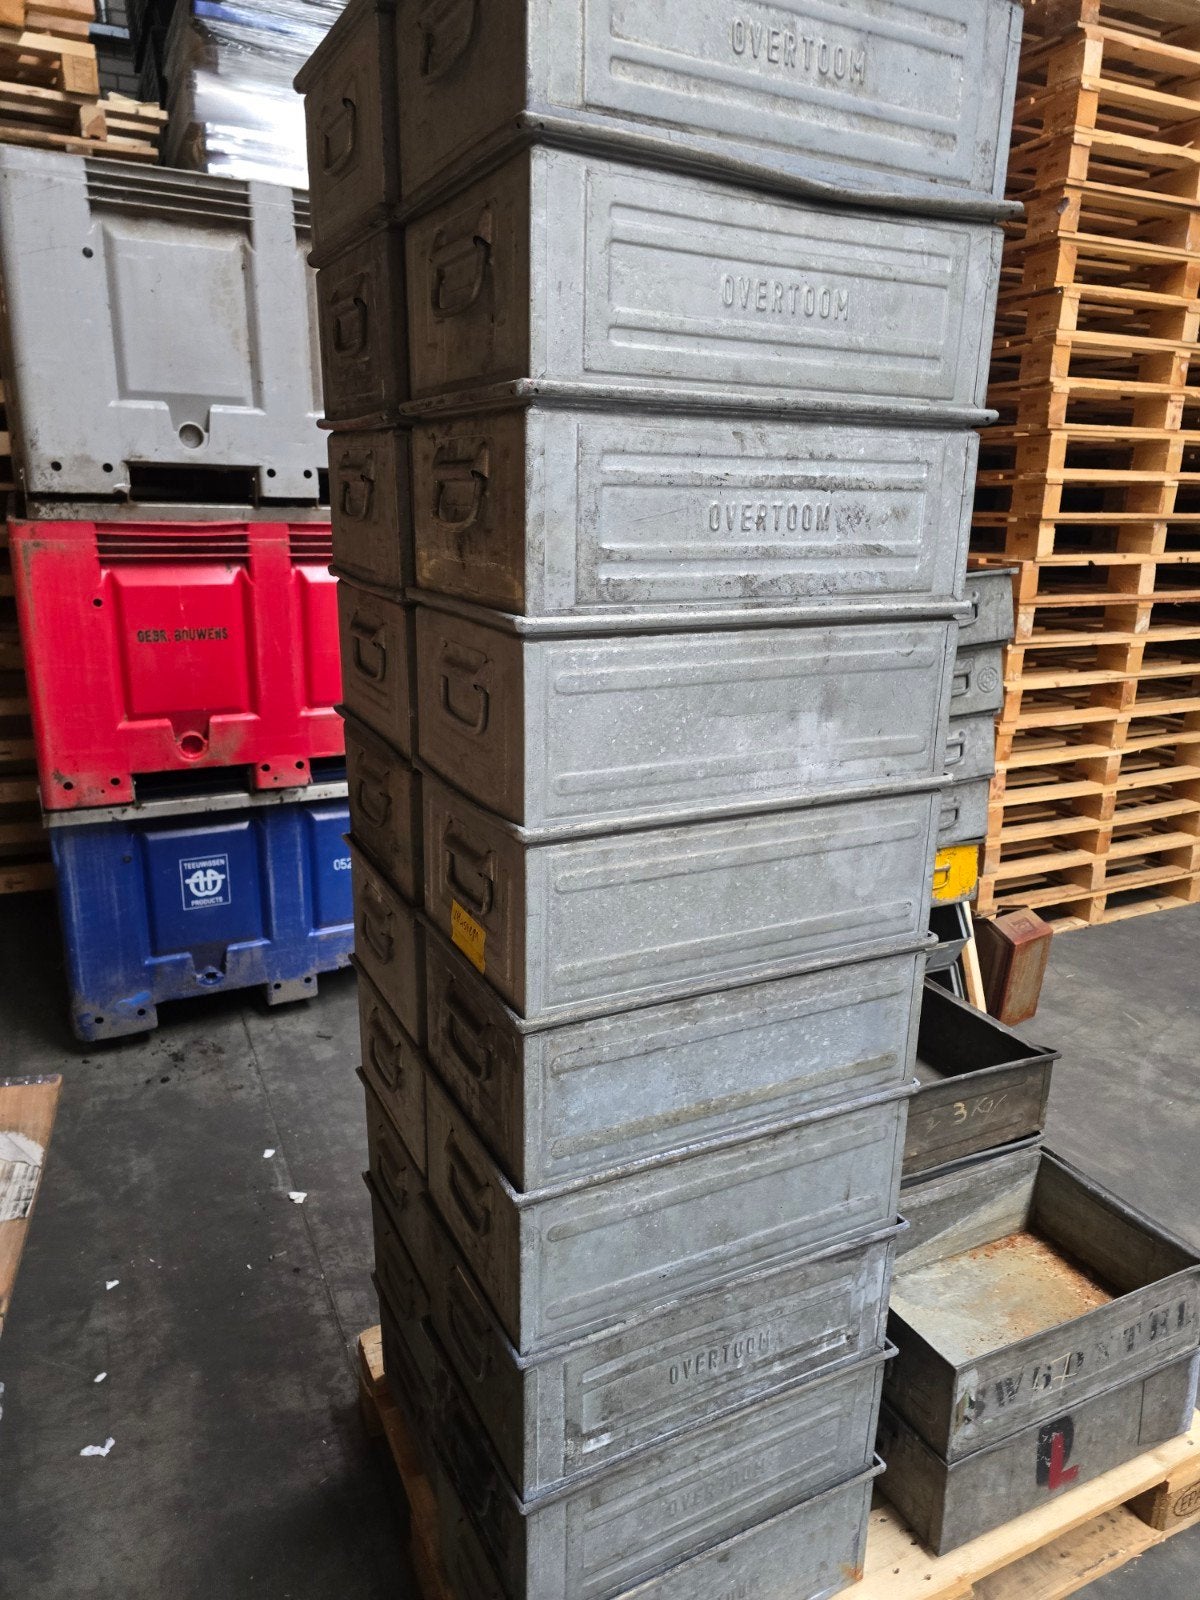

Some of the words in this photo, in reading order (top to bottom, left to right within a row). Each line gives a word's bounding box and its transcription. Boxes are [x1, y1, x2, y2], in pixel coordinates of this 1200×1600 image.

[731, 16, 867, 86] OVERTOOM
[720, 273, 850, 321] OVERTOOM
[709, 502, 831, 532] OVERTOOM
[174, 627, 228, 642] BOUWENS
[190, 896, 223, 907] PRODUCTS
[952, 1102, 967, 1126] 3
[668, 1330, 771, 1385] OVERTOOM
